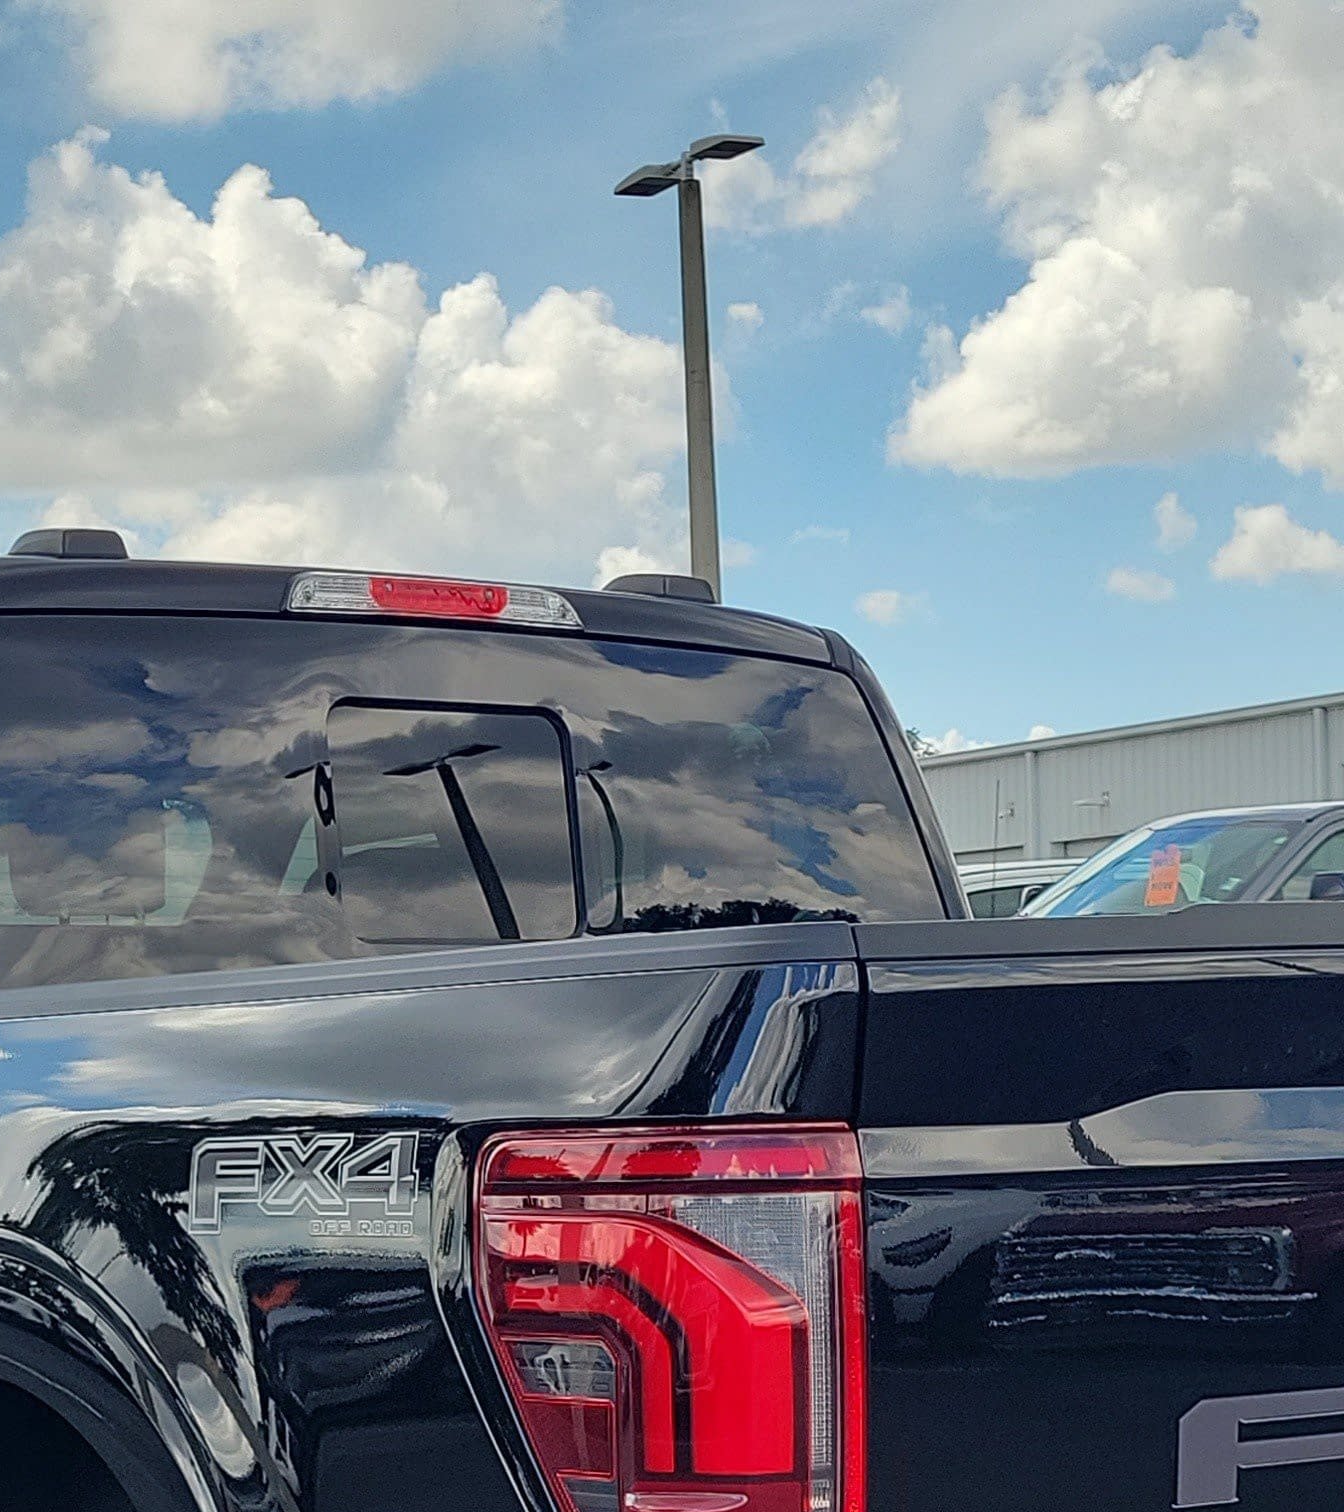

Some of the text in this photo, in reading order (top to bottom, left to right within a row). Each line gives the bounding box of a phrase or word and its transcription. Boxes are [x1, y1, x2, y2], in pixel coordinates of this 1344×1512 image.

[189, 1131, 420, 1235] FX4
[309, 1219, 414, 1236] OFF ROAD
